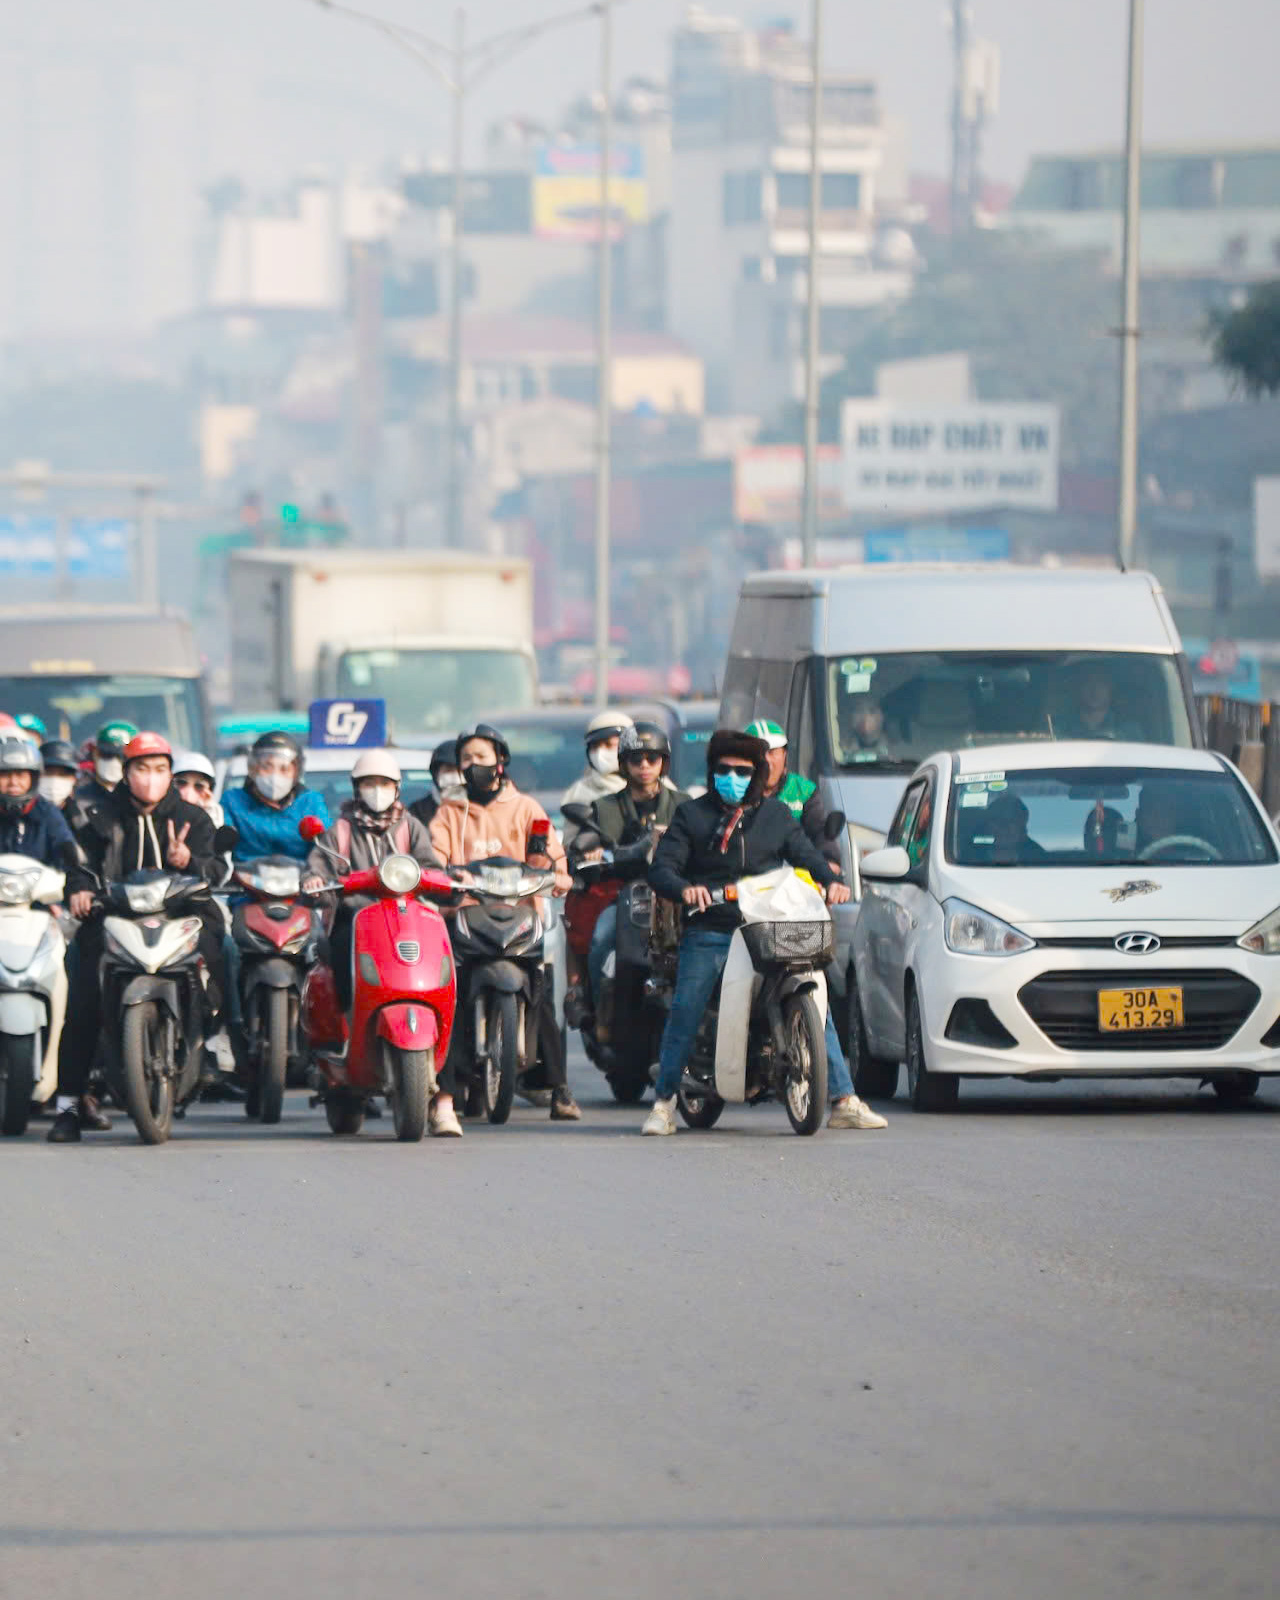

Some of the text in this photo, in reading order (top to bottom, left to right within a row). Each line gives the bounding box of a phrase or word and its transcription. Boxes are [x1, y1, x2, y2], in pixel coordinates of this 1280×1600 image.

[326, 702, 369, 745] G7
[1122, 990, 1159, 1009] 30A
[1108, 1008, 1176, 1029] 413.29
